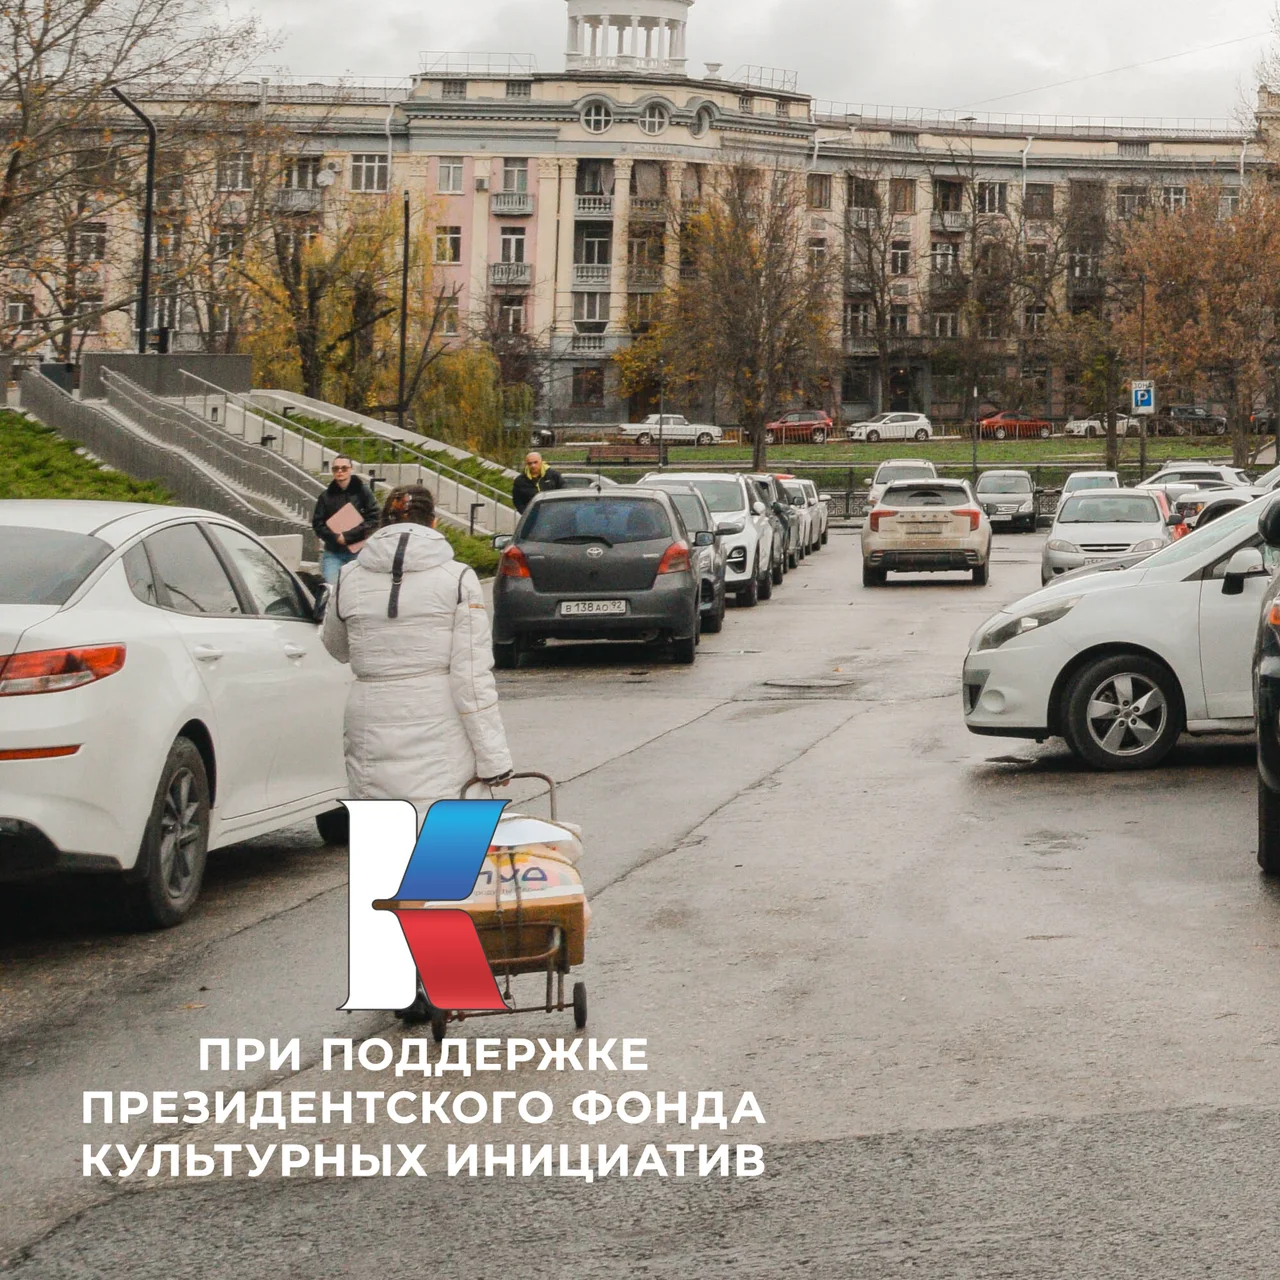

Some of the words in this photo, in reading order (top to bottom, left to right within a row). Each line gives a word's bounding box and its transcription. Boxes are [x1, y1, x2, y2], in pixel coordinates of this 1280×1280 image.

[1137, 390, 1149, 405] P
[565, 603, 609, 612] В138АО
[610, 601, 622, 609] 92
